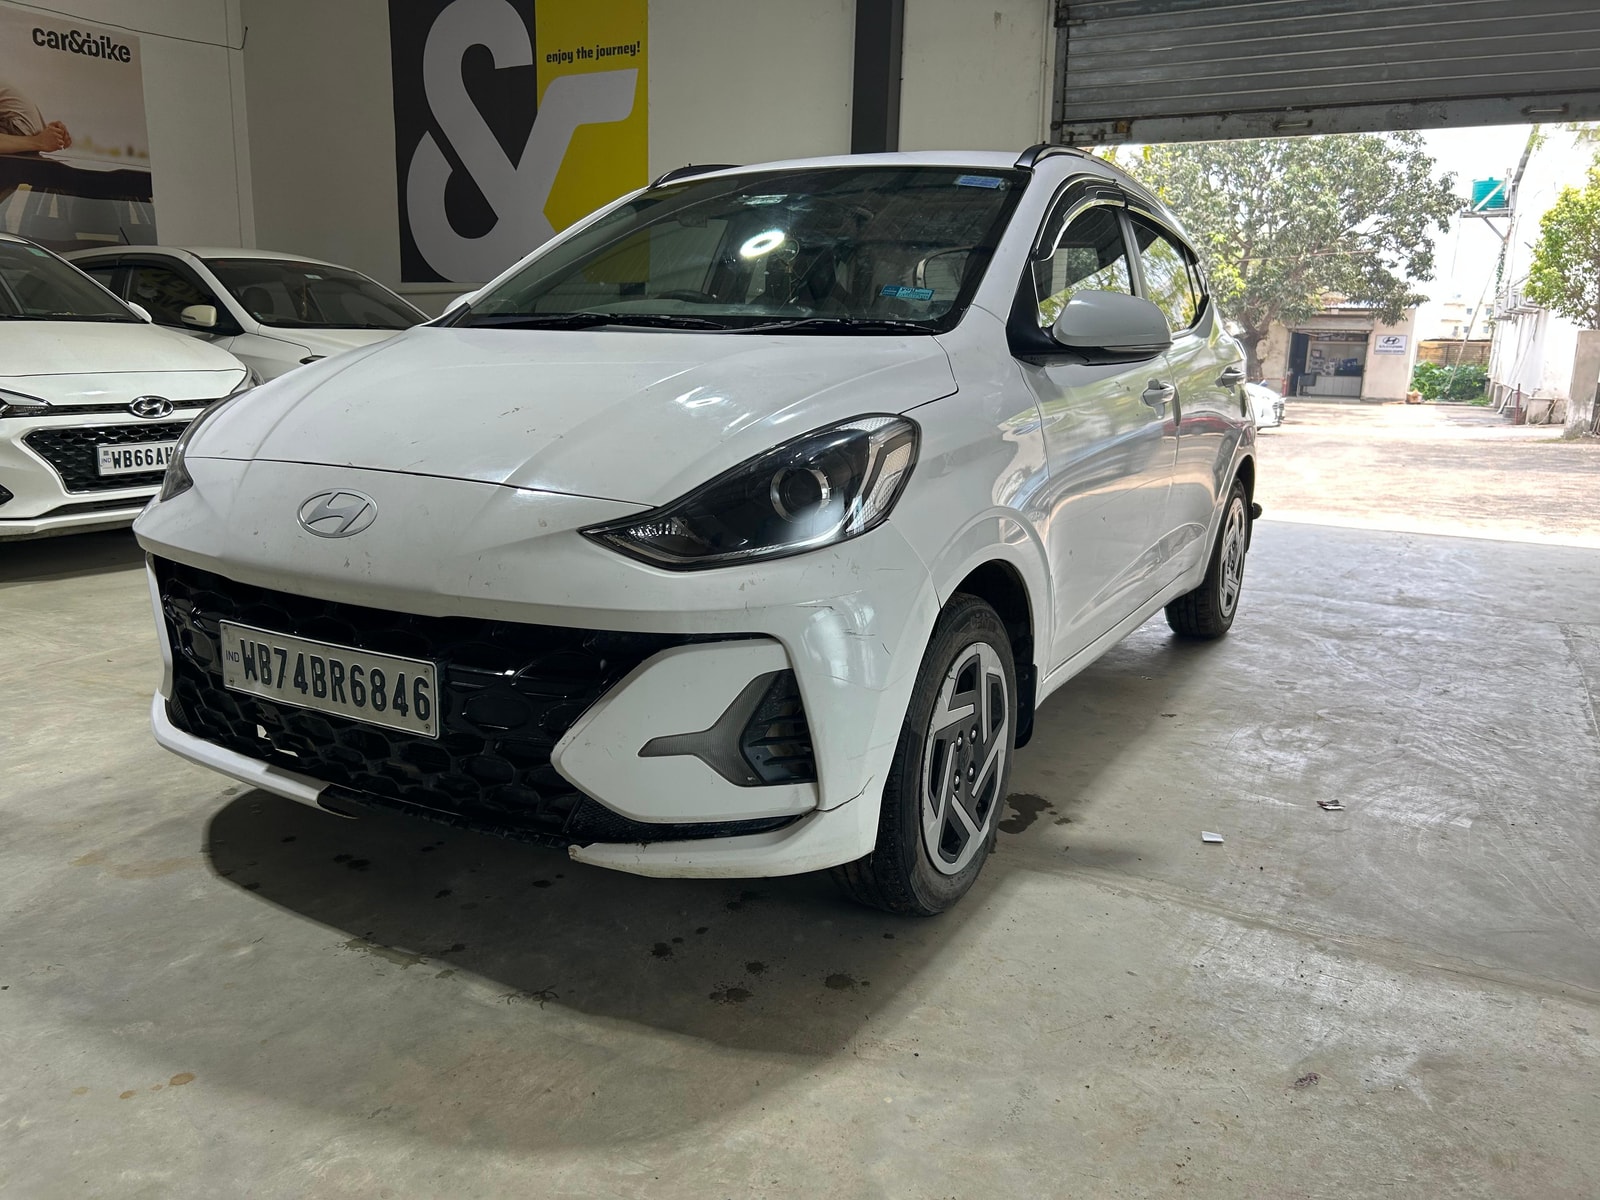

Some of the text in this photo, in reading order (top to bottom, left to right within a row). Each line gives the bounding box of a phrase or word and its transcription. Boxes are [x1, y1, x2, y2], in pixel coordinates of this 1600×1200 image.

[32, 27, 131, 63] car&bike
[546, 41, 641, 64] enjoy the journey!
[225, 649, 240, 663] IND
[239, 638, 431, 721] WB74BR6846
